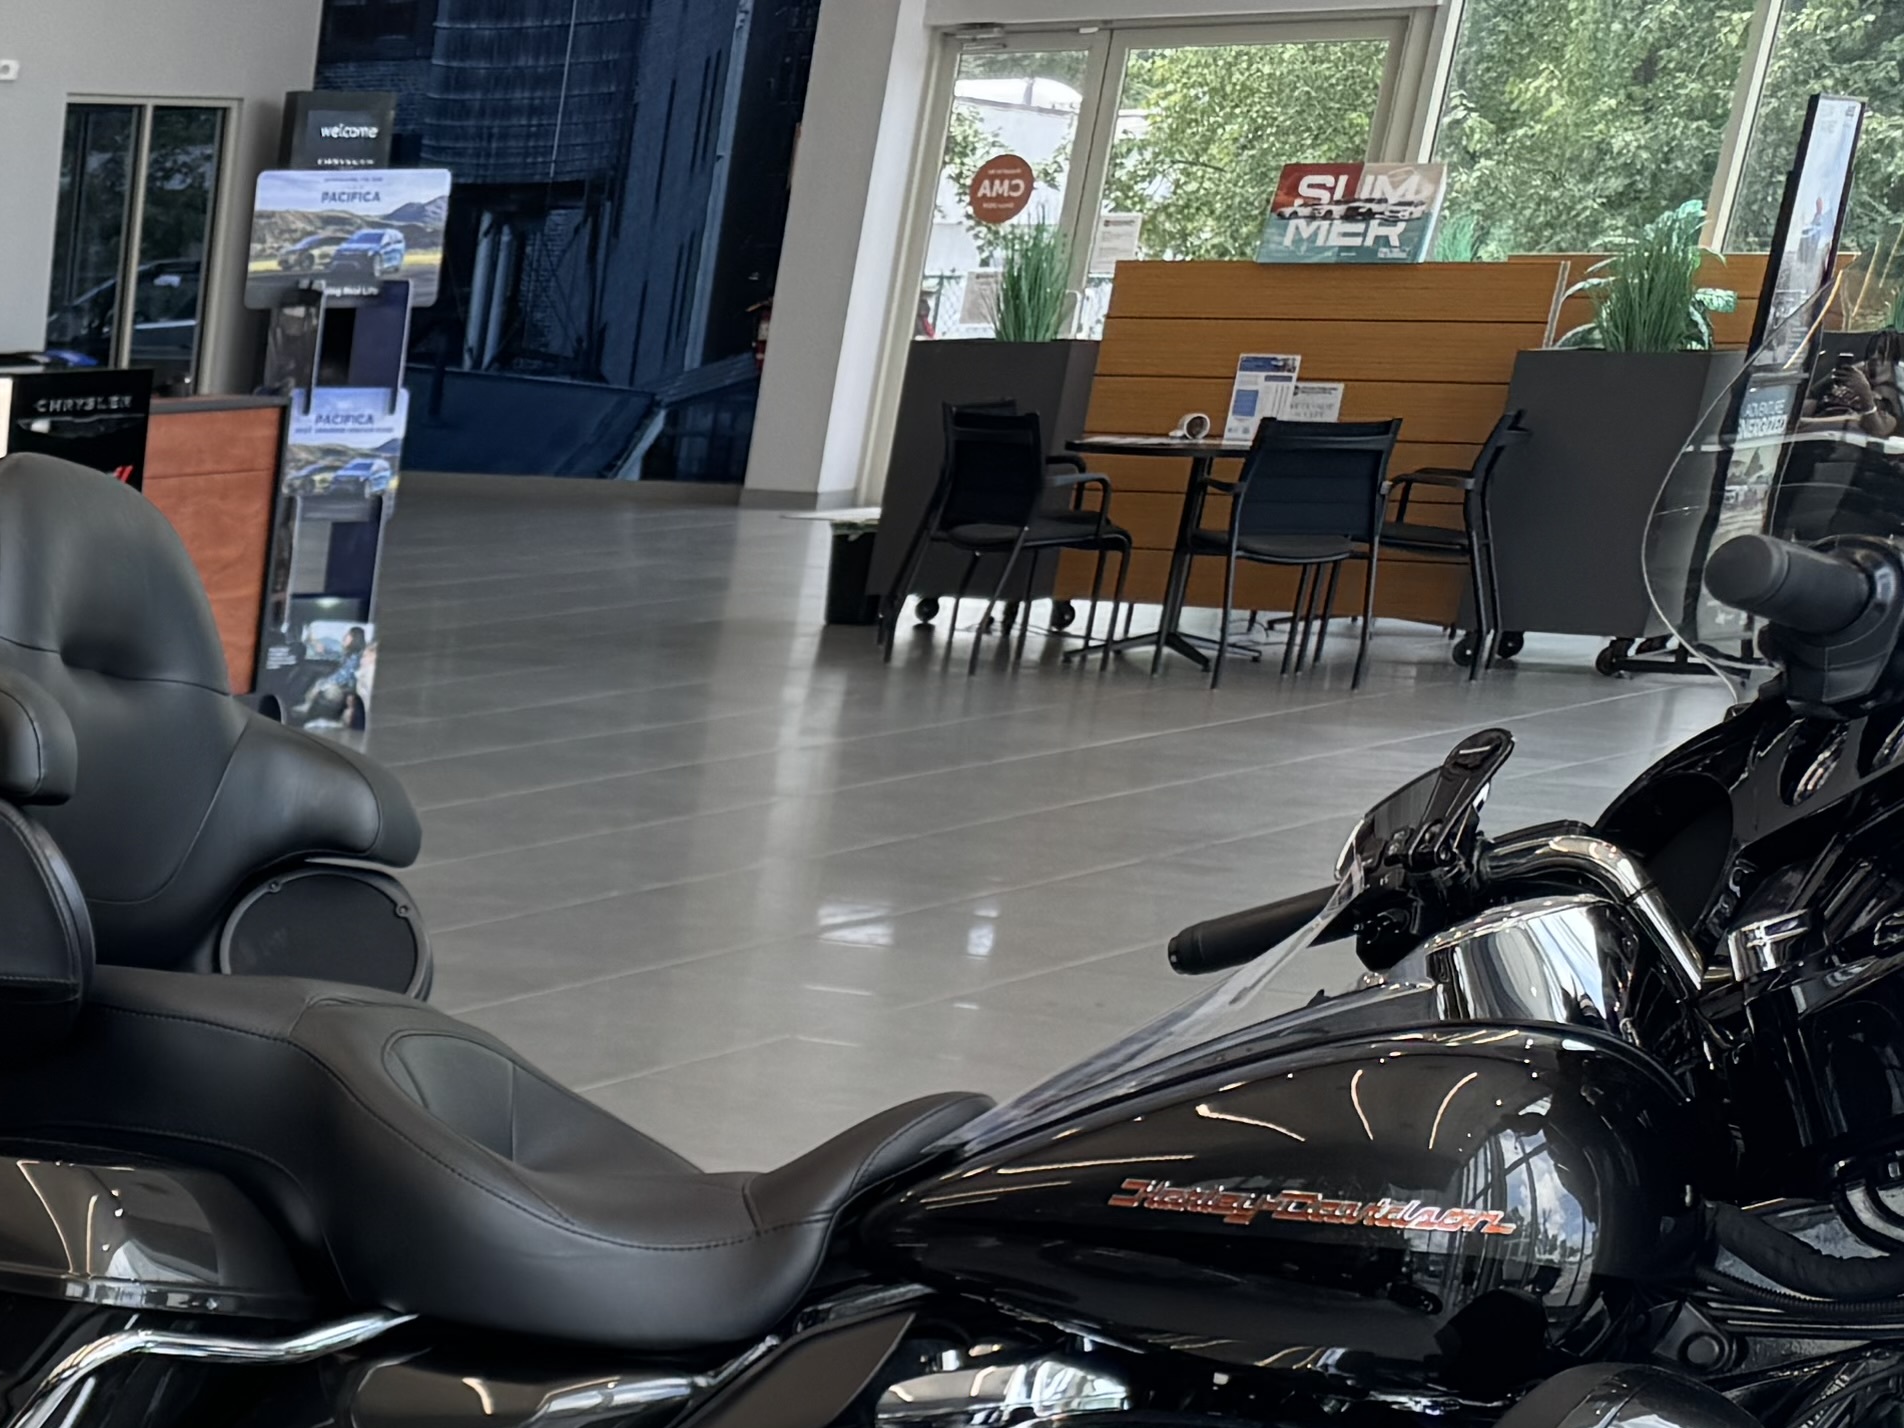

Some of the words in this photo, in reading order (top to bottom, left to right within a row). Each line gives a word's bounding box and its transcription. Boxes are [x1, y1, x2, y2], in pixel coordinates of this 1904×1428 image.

[320, 123, 379, 138] welcome
[320, 191, 381, 204] PACIFICA
[35, 395, 134, 413] CHRYSLER
[1107, 1177, 1517, 1236] Harley-Davidson
